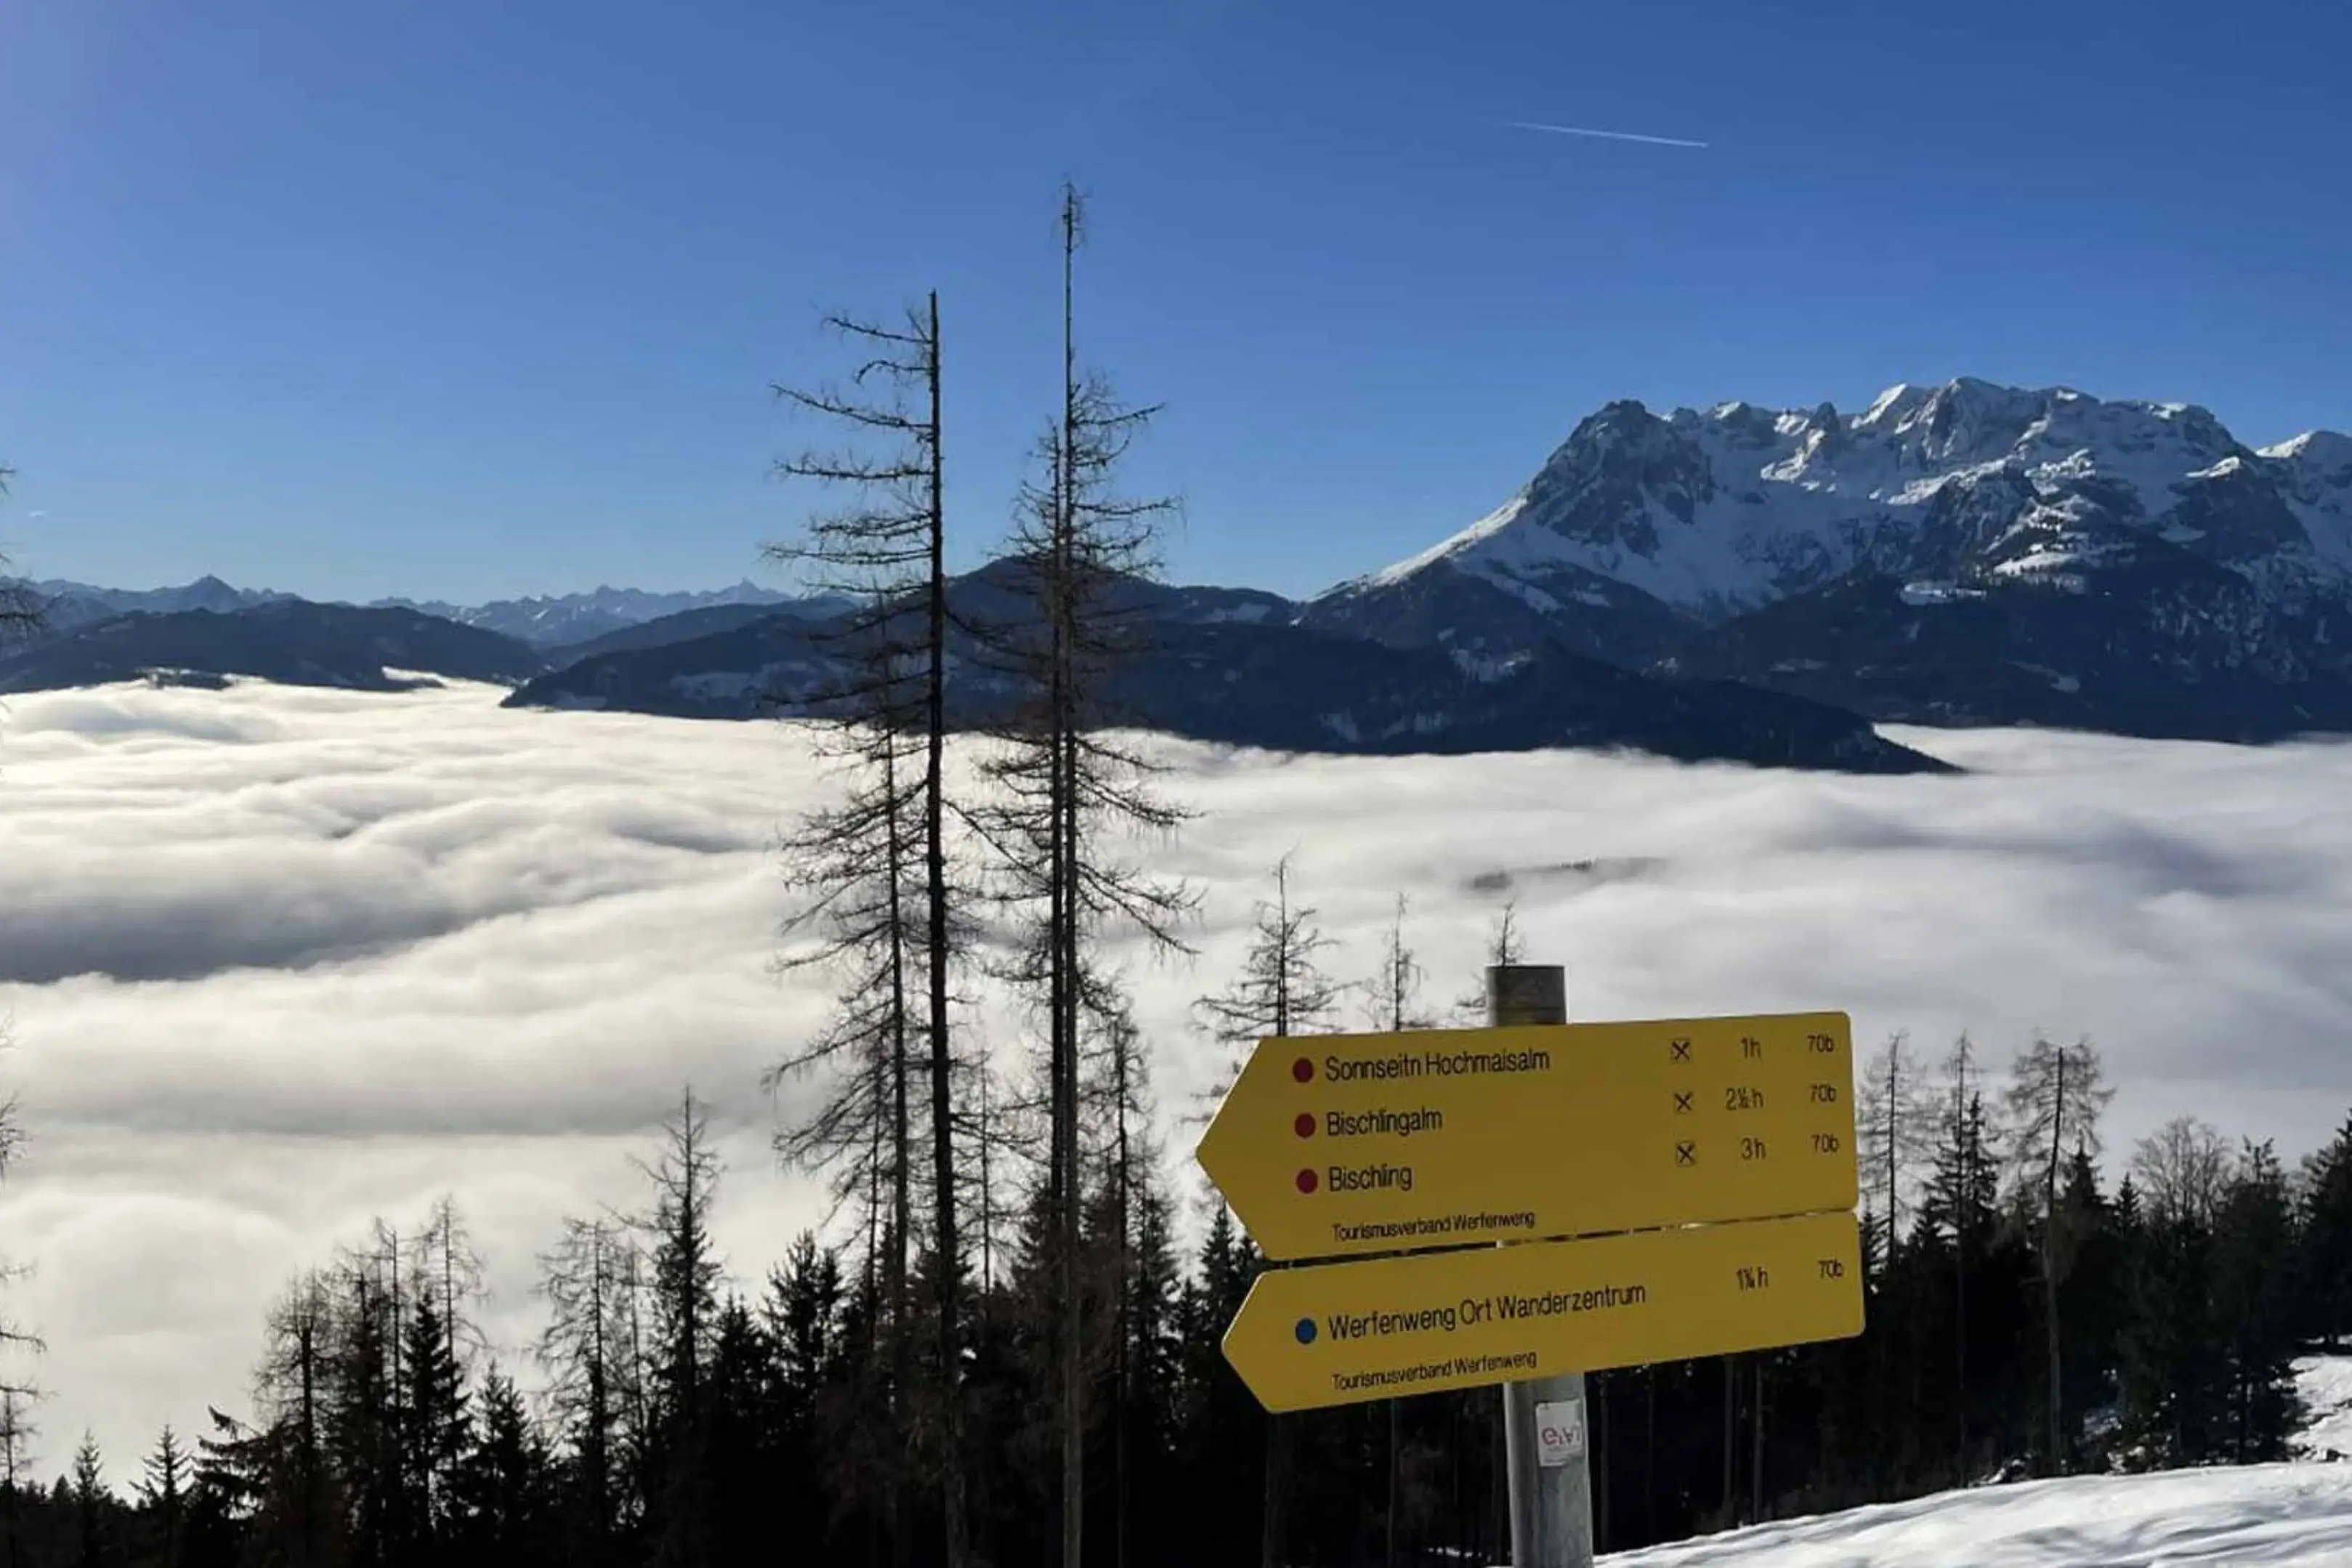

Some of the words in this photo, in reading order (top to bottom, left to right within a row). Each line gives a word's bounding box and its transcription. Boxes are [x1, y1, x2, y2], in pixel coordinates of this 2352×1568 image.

[1806, 1034, 1835, 1053] 70b
[1325, 1053, 1421, 1083] Sonnseitn
[1426, 1048, 1550, 1077] Hochmaisalm
[1810, 1084, 1837, 1102] 70b
[1326, 1105, 1443, 1136] Bischlingalm
[1811, 1133, 1840, 1153] 70b
[1328, 1163, 1413, 1192] Bischling
[1333, 1216, 1451, 1241] Tourismusverband
[1453, 1211, 1535, 1232] Werfenweng
[1818, 1258, 1843, 1279] 70b
[1328, 1307, 1456, 1340] Werfenweng
[1460, 1298, 1492, 1325] Ort
[1496, 1284, 1646, 1320] Wanderzentrum
[1331, 1357, 1452, 1390] Tourismusverband
[1454, 1351, 1537, 1375] Werfenweng
